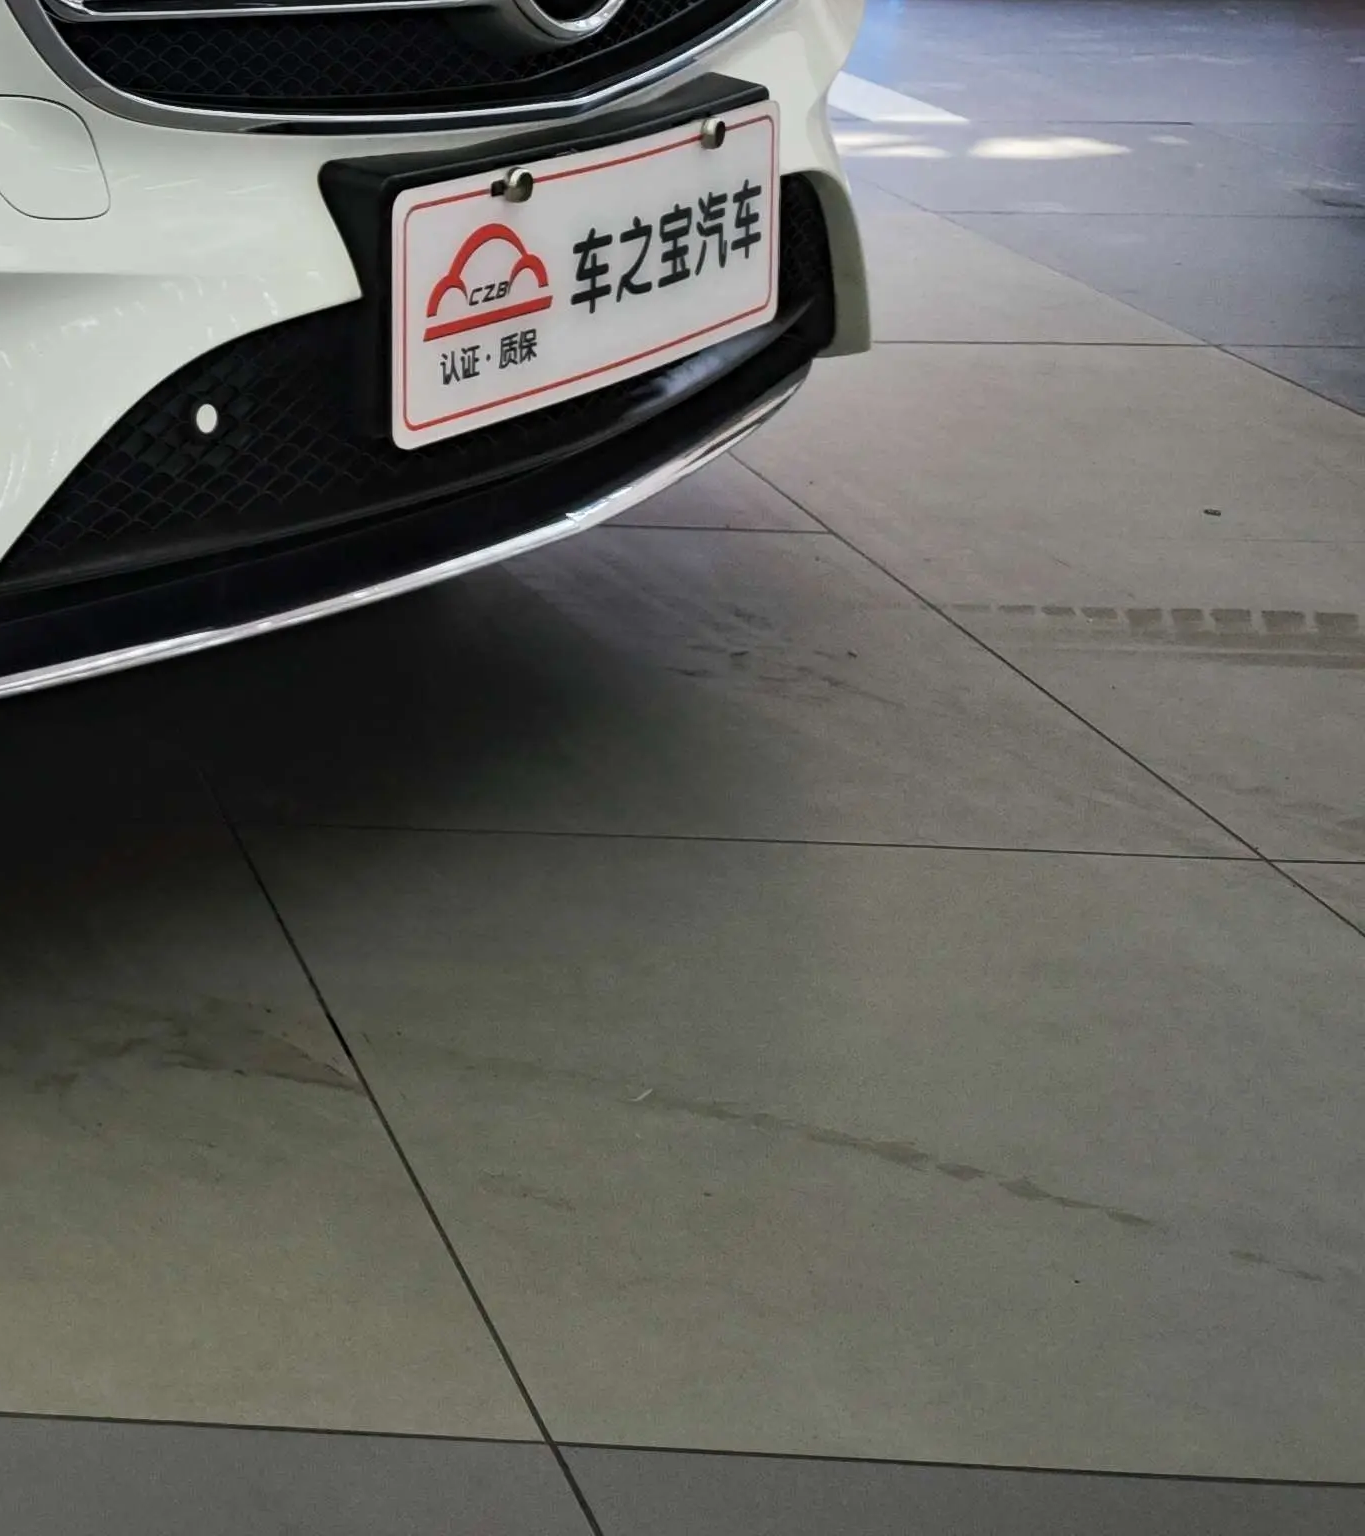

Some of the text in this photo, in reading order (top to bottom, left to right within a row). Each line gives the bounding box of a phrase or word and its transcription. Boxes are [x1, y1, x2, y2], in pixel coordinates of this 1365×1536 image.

[570, 178, 763, 314] 车之宝汽车
[468, 280, 510, 307] CZB
